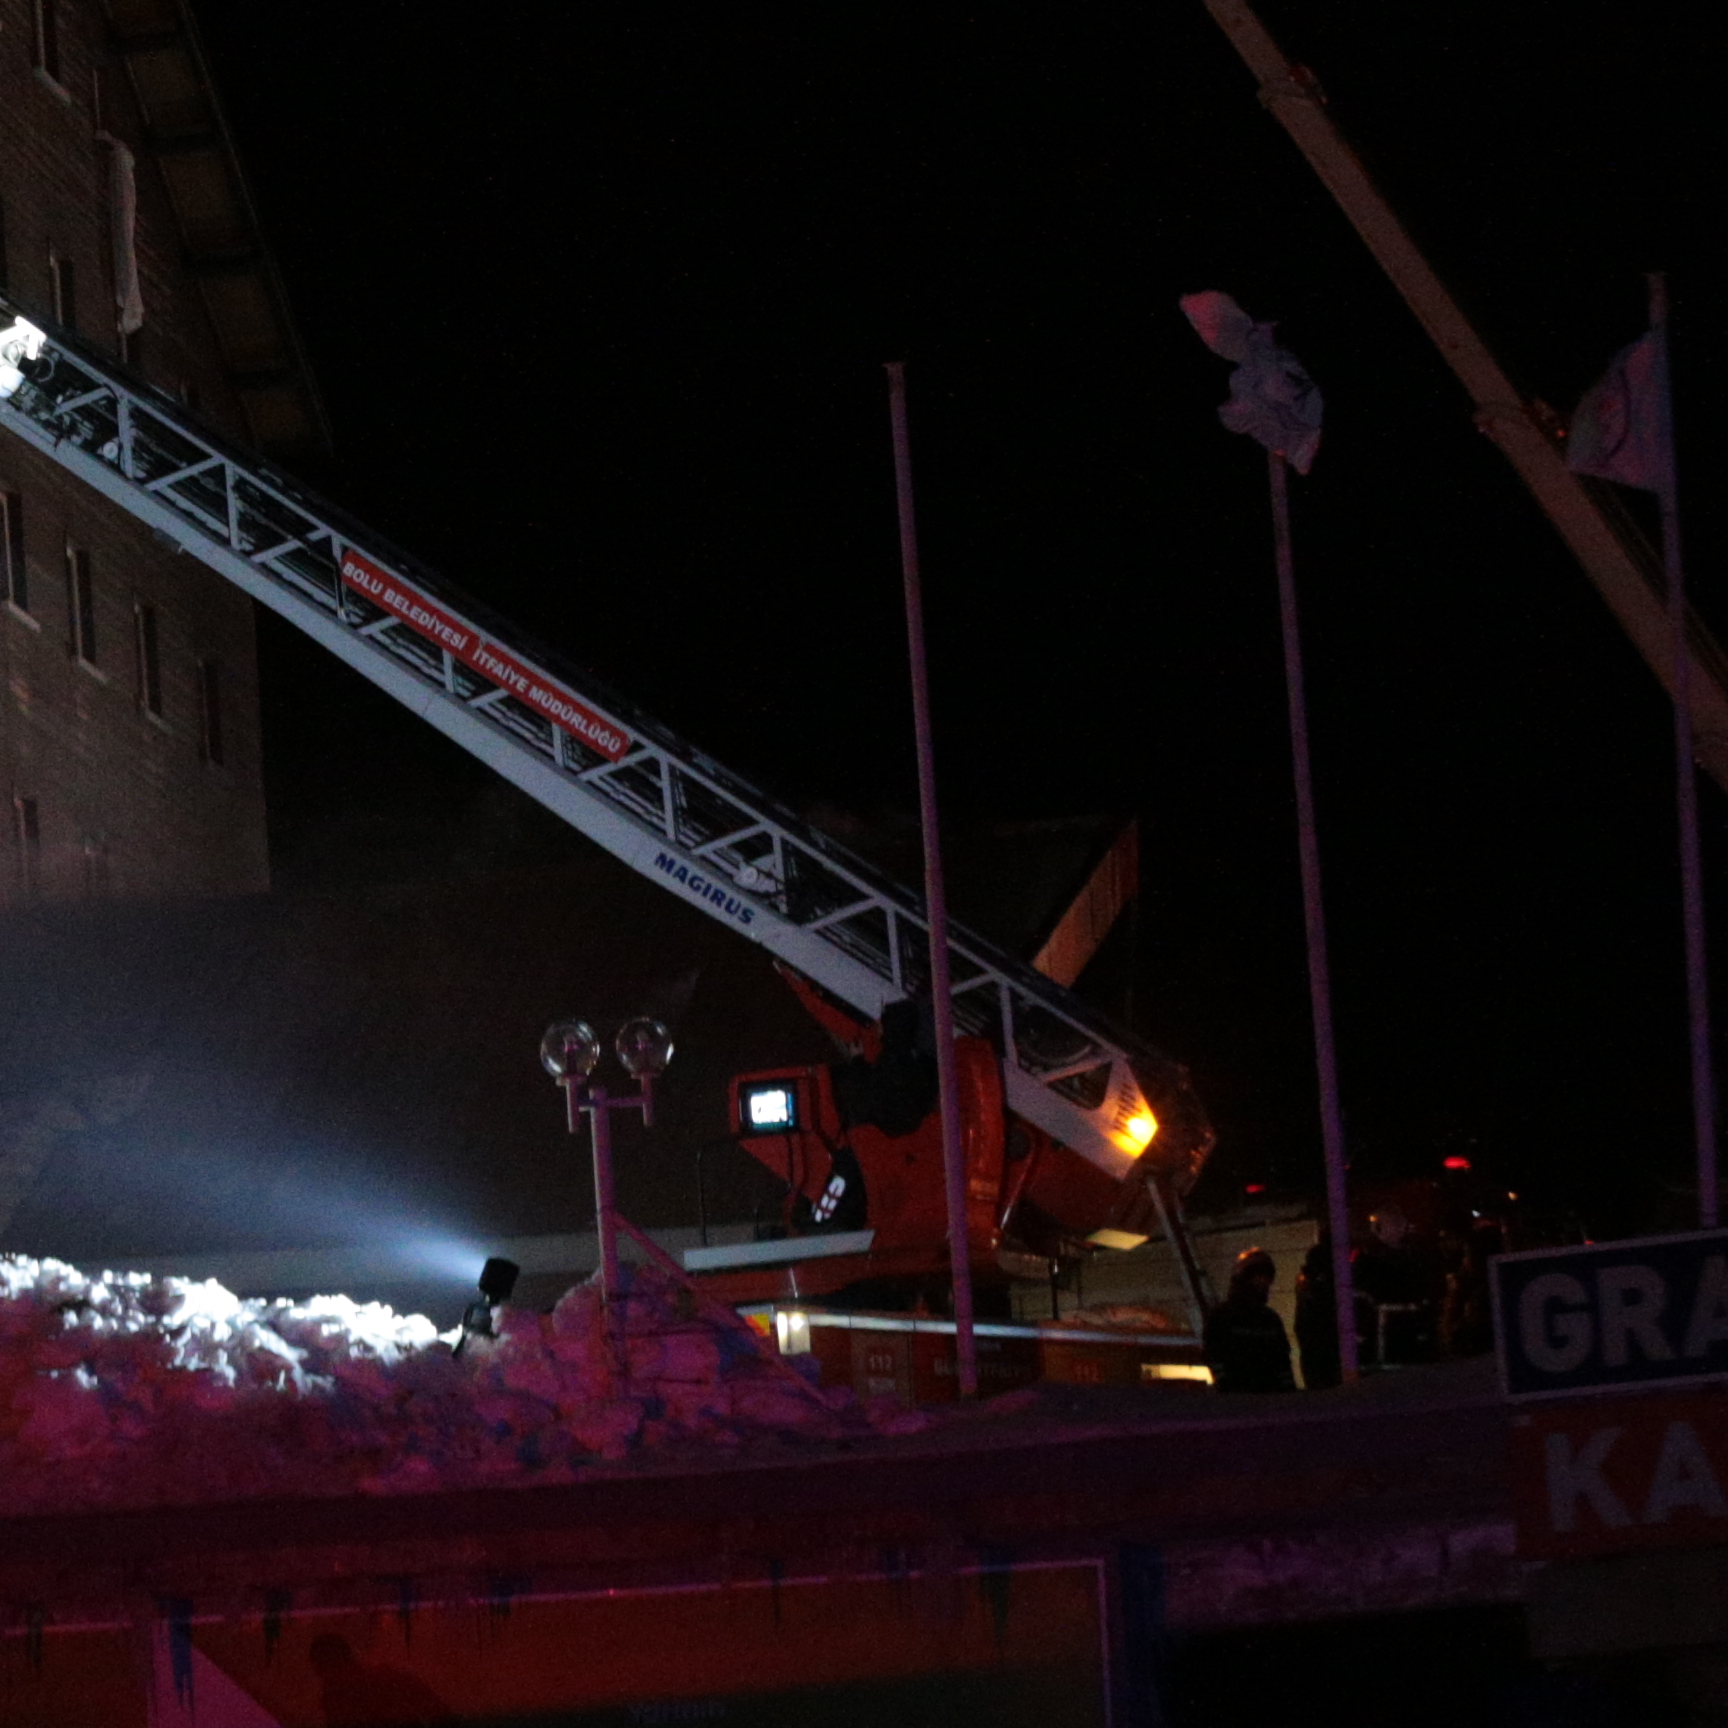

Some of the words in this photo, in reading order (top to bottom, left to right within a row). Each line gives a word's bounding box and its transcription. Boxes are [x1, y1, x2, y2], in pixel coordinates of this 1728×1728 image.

[342, 561, 384, 596] BOLU
[382, 588, 469, 651] BELEDİYESİ
[472, 645, 530, 694] İTFAİYE
[529, 684, 621, 754] MÜDÜRLÜĞÜ
[654, 851, 756, 924] MAGIRUS
[1518, 1254, 1728, 1373] GRA
[1545, 1420, 1728, 1533] KA
